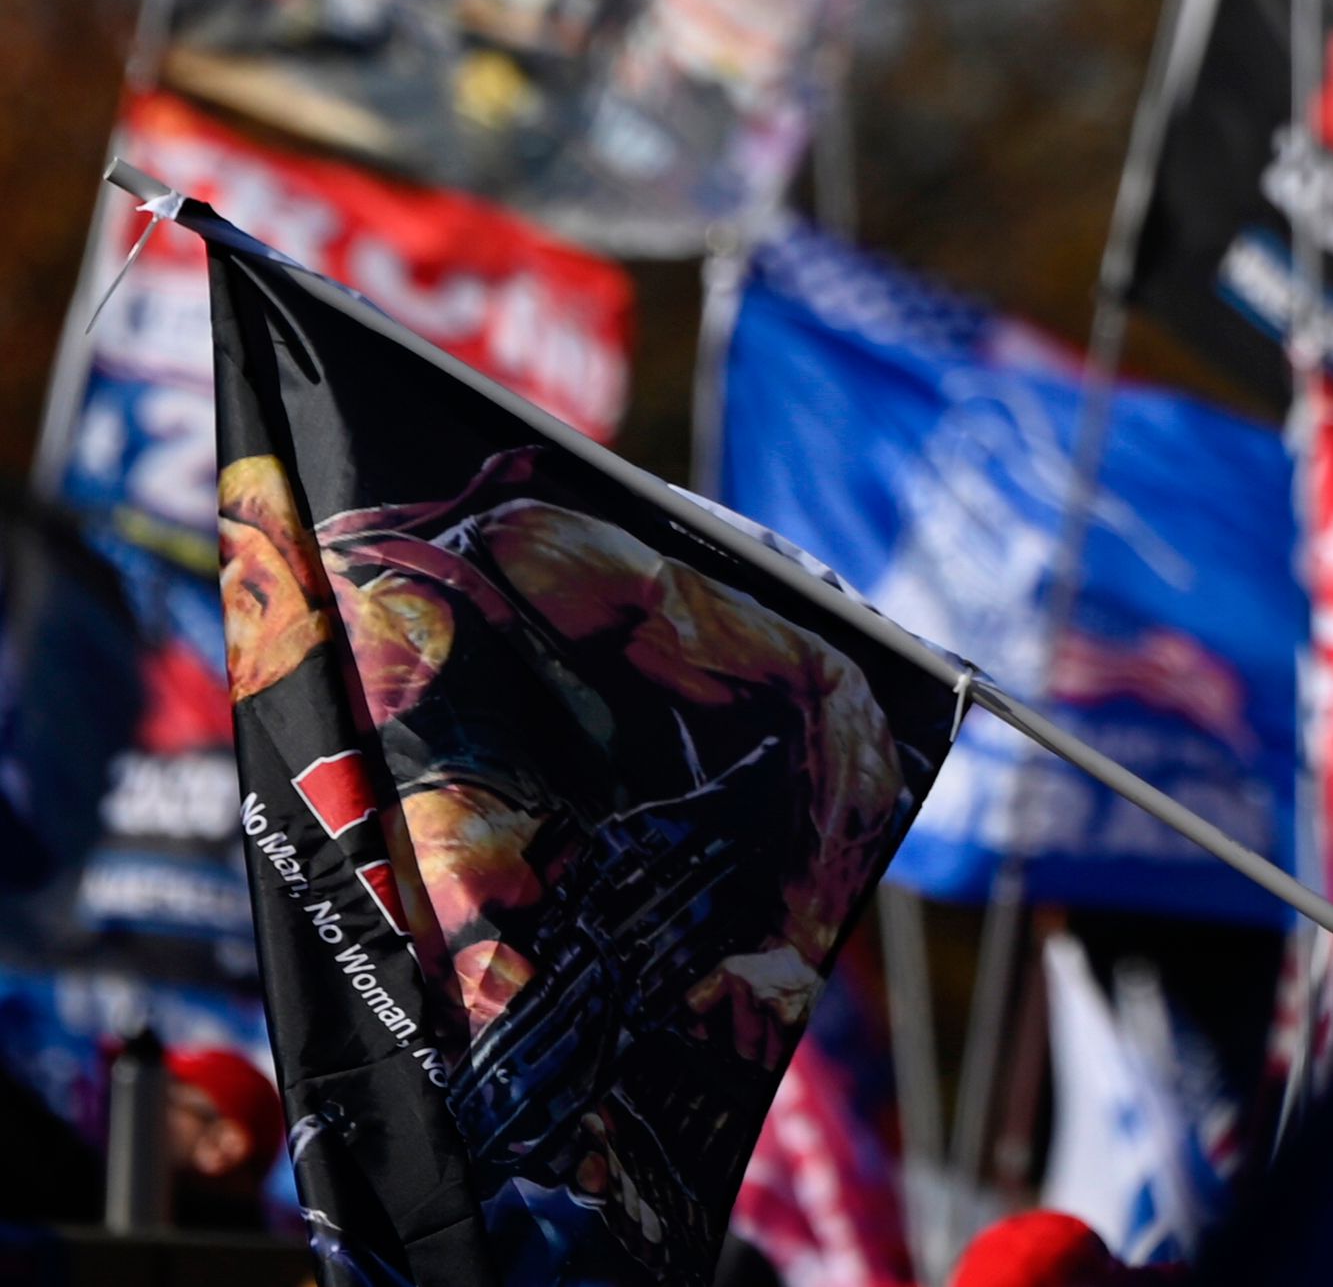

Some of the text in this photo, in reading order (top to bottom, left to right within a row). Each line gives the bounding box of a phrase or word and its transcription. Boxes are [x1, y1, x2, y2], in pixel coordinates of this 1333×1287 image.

[240, 792, 268, 836] No
[304, 899, 344, 945] No
[335, 942, 418, 1050] Woman,
[412, 1046, 449, 1089] No
